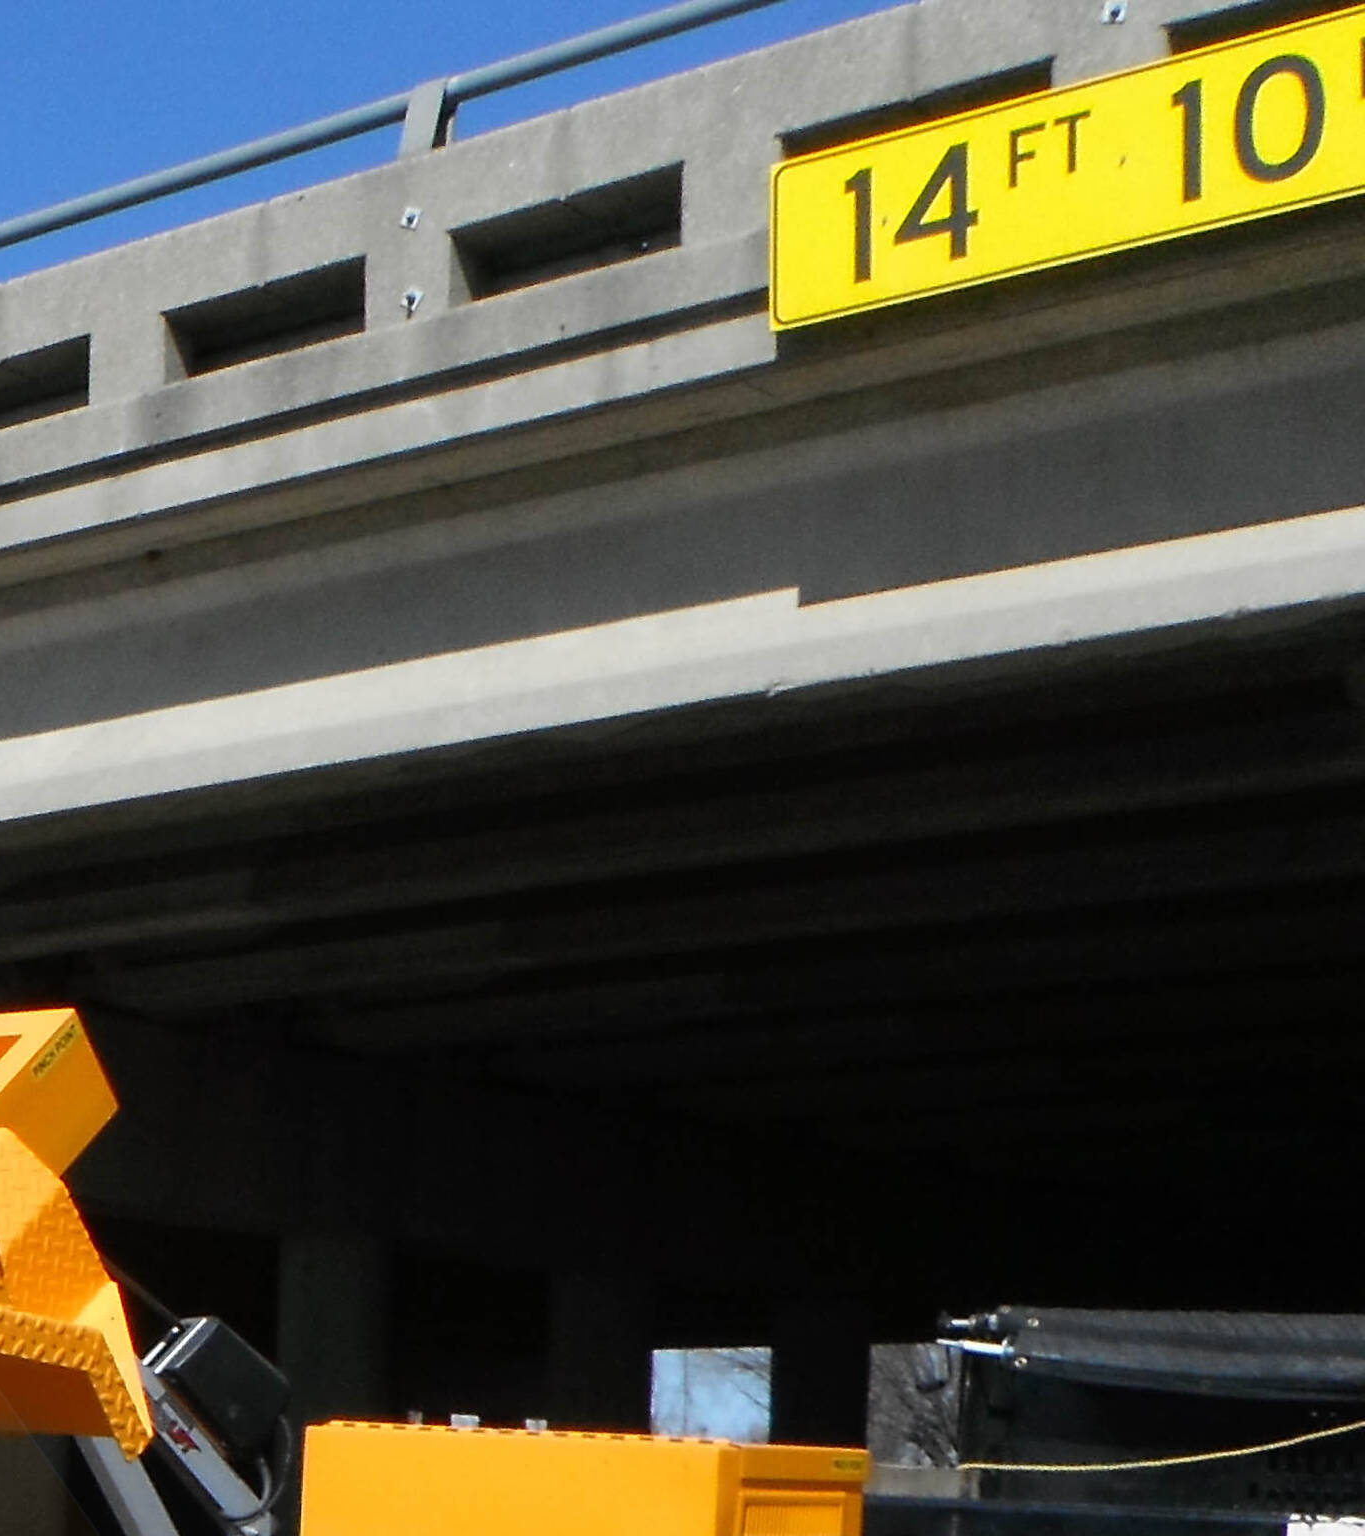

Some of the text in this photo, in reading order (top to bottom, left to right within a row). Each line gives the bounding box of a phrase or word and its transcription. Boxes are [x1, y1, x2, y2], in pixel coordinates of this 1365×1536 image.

[844, 142, 979, 285] 14
[1008, 110, 1091, 190] FT
[1172, 53, 1327, 204] 10
